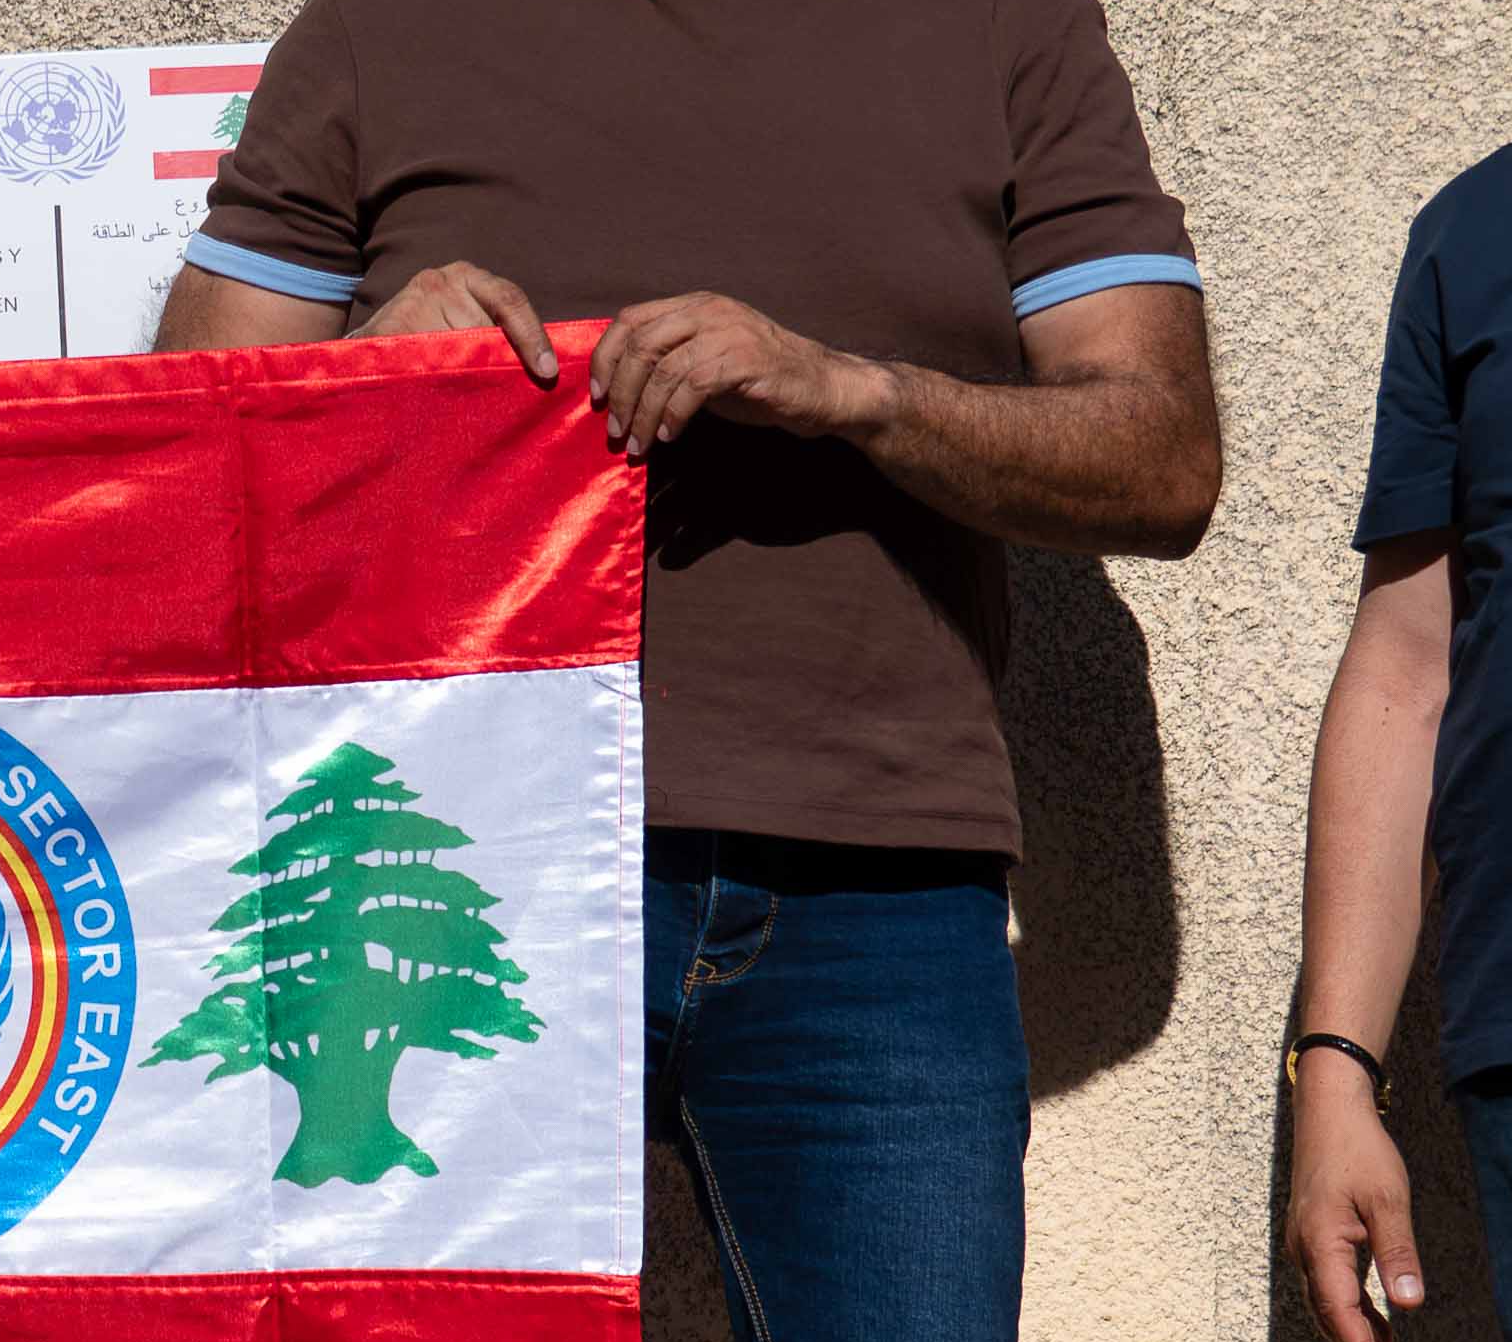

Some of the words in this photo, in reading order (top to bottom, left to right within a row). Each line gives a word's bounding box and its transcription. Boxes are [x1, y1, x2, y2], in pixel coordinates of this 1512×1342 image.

[92, 222, 135, 240] الطاقة
[142, 221, 172, 243] على
[8, 247, 22, 264] Y
[36, 1002, 120, 1156] EAST
